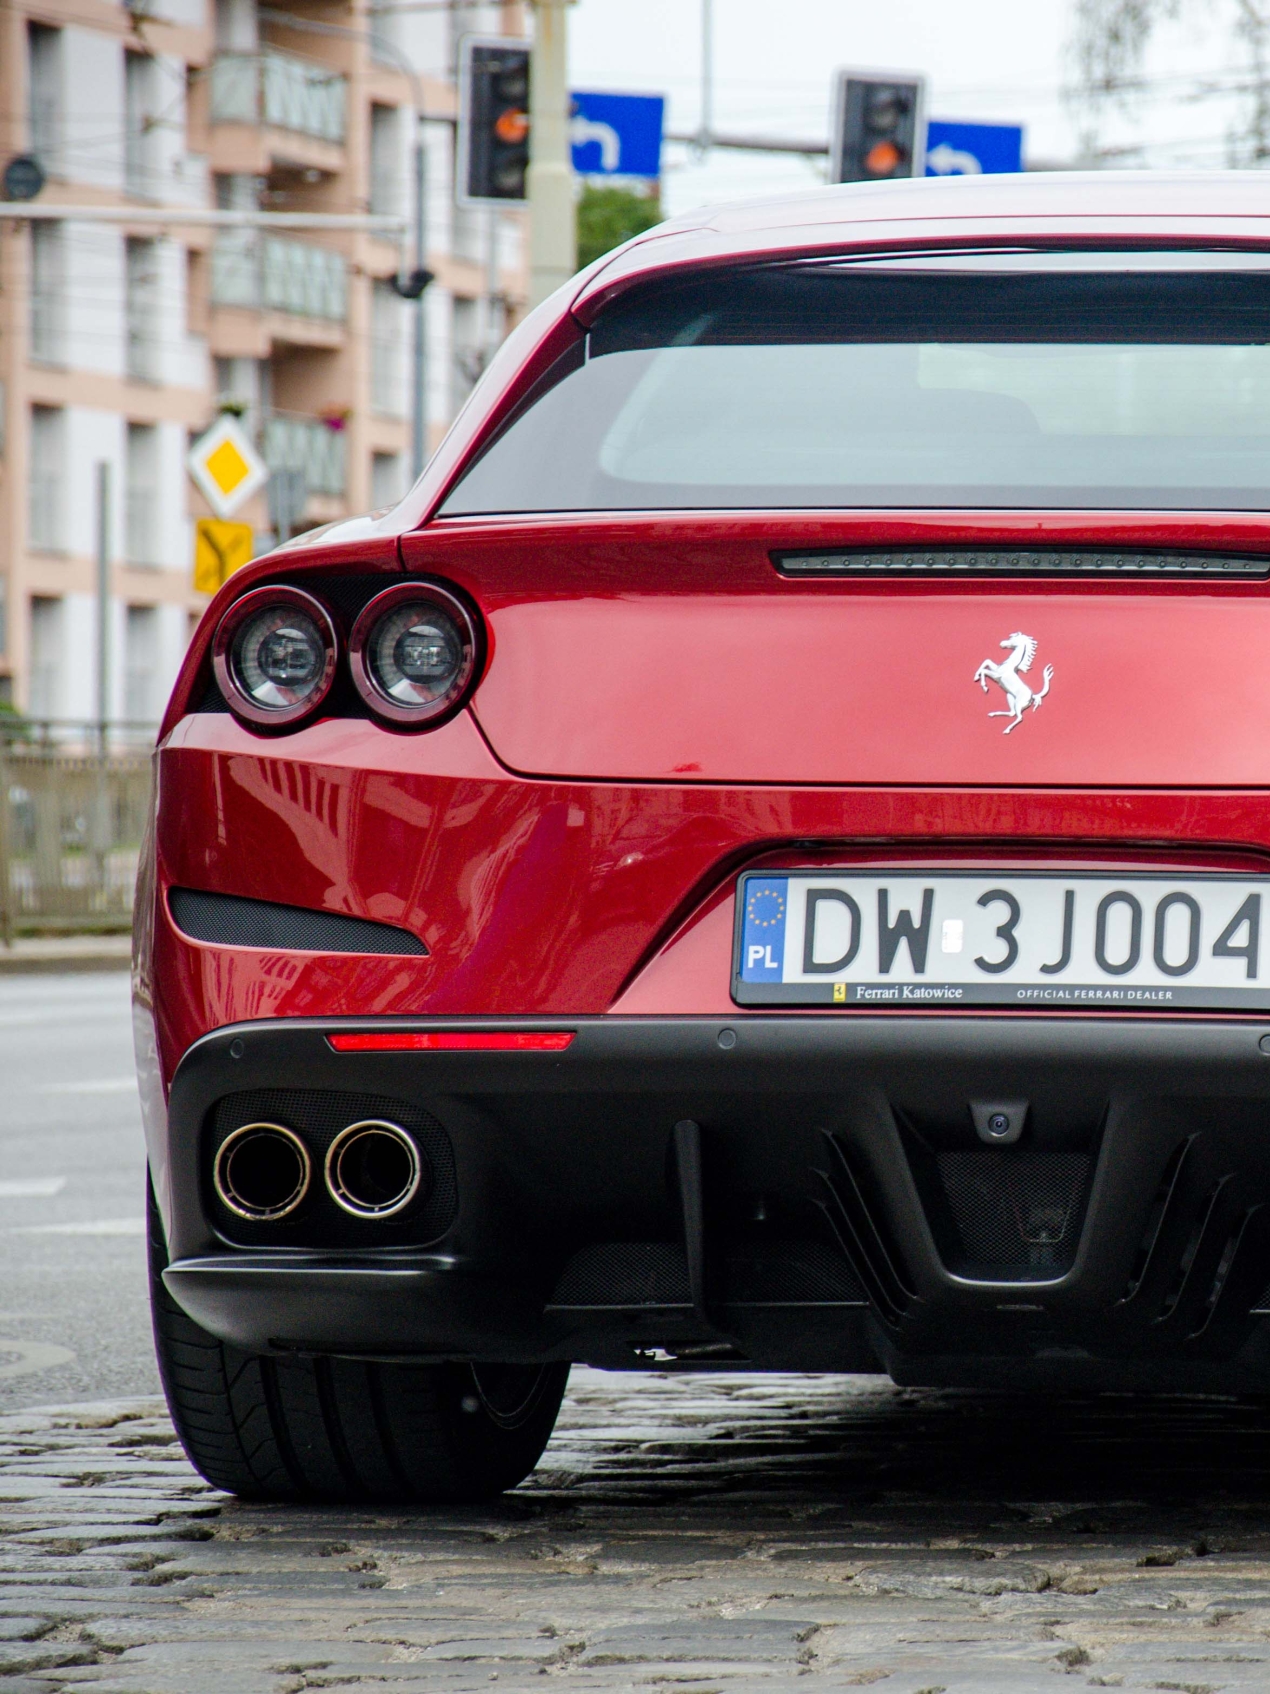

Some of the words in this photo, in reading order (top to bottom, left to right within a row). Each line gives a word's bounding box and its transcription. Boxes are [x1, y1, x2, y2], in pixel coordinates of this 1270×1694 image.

[803, 888, 934, 974] DW
[974, 889, 1262, 979] 3J004
[748, 945, 778, 969] PL
[855, 985, 899, 999] Ferrari
[902, 985, 963, 999] Katowice
[1017, 989, 1071, 999] OFFICIAL
[1074, 989, 1124, 1000] FERRARI
[1127, 990, 1173, 1001] DEALER
